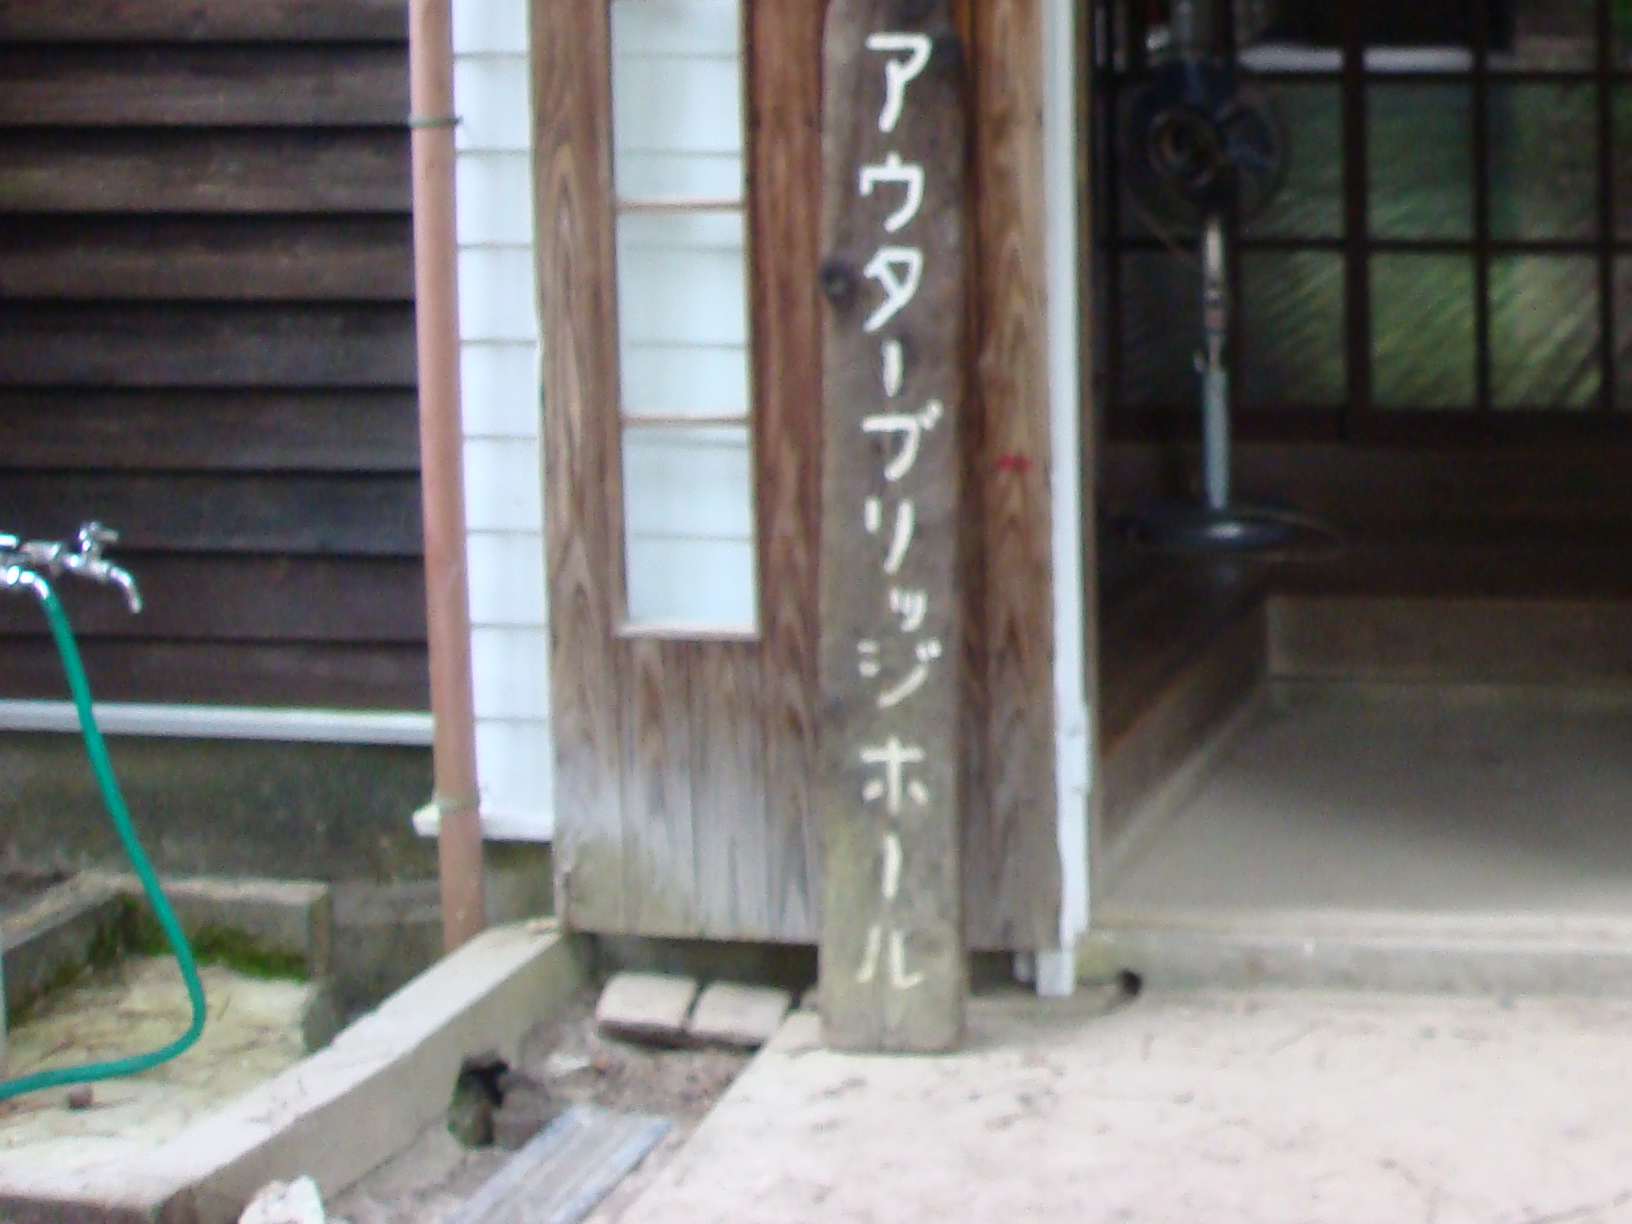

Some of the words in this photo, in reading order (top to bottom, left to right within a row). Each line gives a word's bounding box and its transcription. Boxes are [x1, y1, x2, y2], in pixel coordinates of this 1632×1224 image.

[856, 32, 943, 990] アウターブリッジホール
